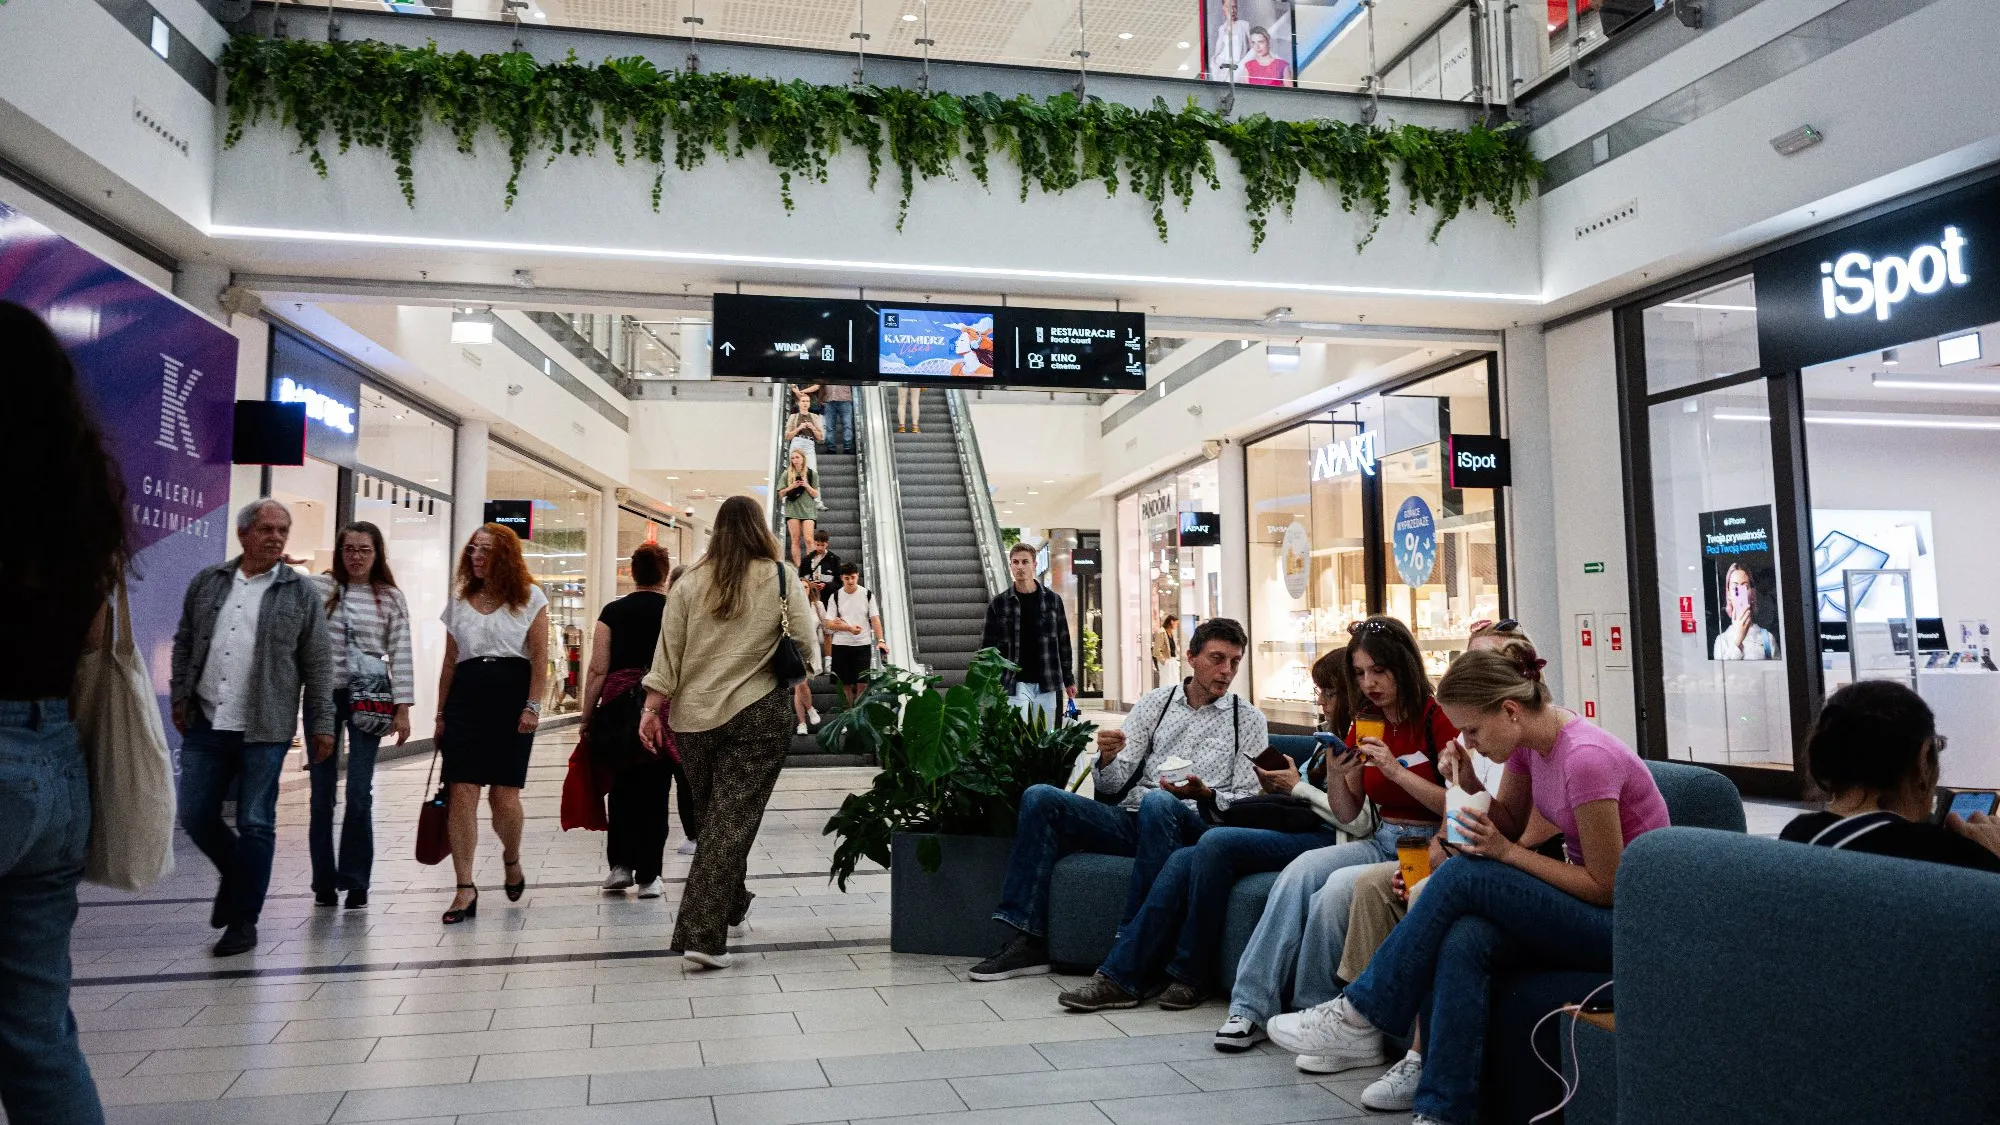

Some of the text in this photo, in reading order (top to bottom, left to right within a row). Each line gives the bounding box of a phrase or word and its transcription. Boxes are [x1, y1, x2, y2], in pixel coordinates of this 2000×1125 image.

[1443, 47, 1468, 73] PINKO
[1820, 225, 1971, 321] iSpot
[884, 333, 945, 346] KAZIMIERZ
[1051, 327, 1115, 338] RESTAURACJE
[774, 342, 809, 353] WINDA
[1051, 354, 1076, 362] KINO
[154, 352, 204, 459] K
[1311, 429, 1378, 482] APART
[1456, 451, 1497, 471] iSpot
[142, 475, 205, 509] GALERIA
[1141, 490, 1172, 521] PANDORA
[131, 503, 210, 538] KAZIMIERZ
[1727, 517, 1747, 525] iPhone
[1706, 533, 1725, 544] Twoja
[1706, 545, 1719, 554] Pod
